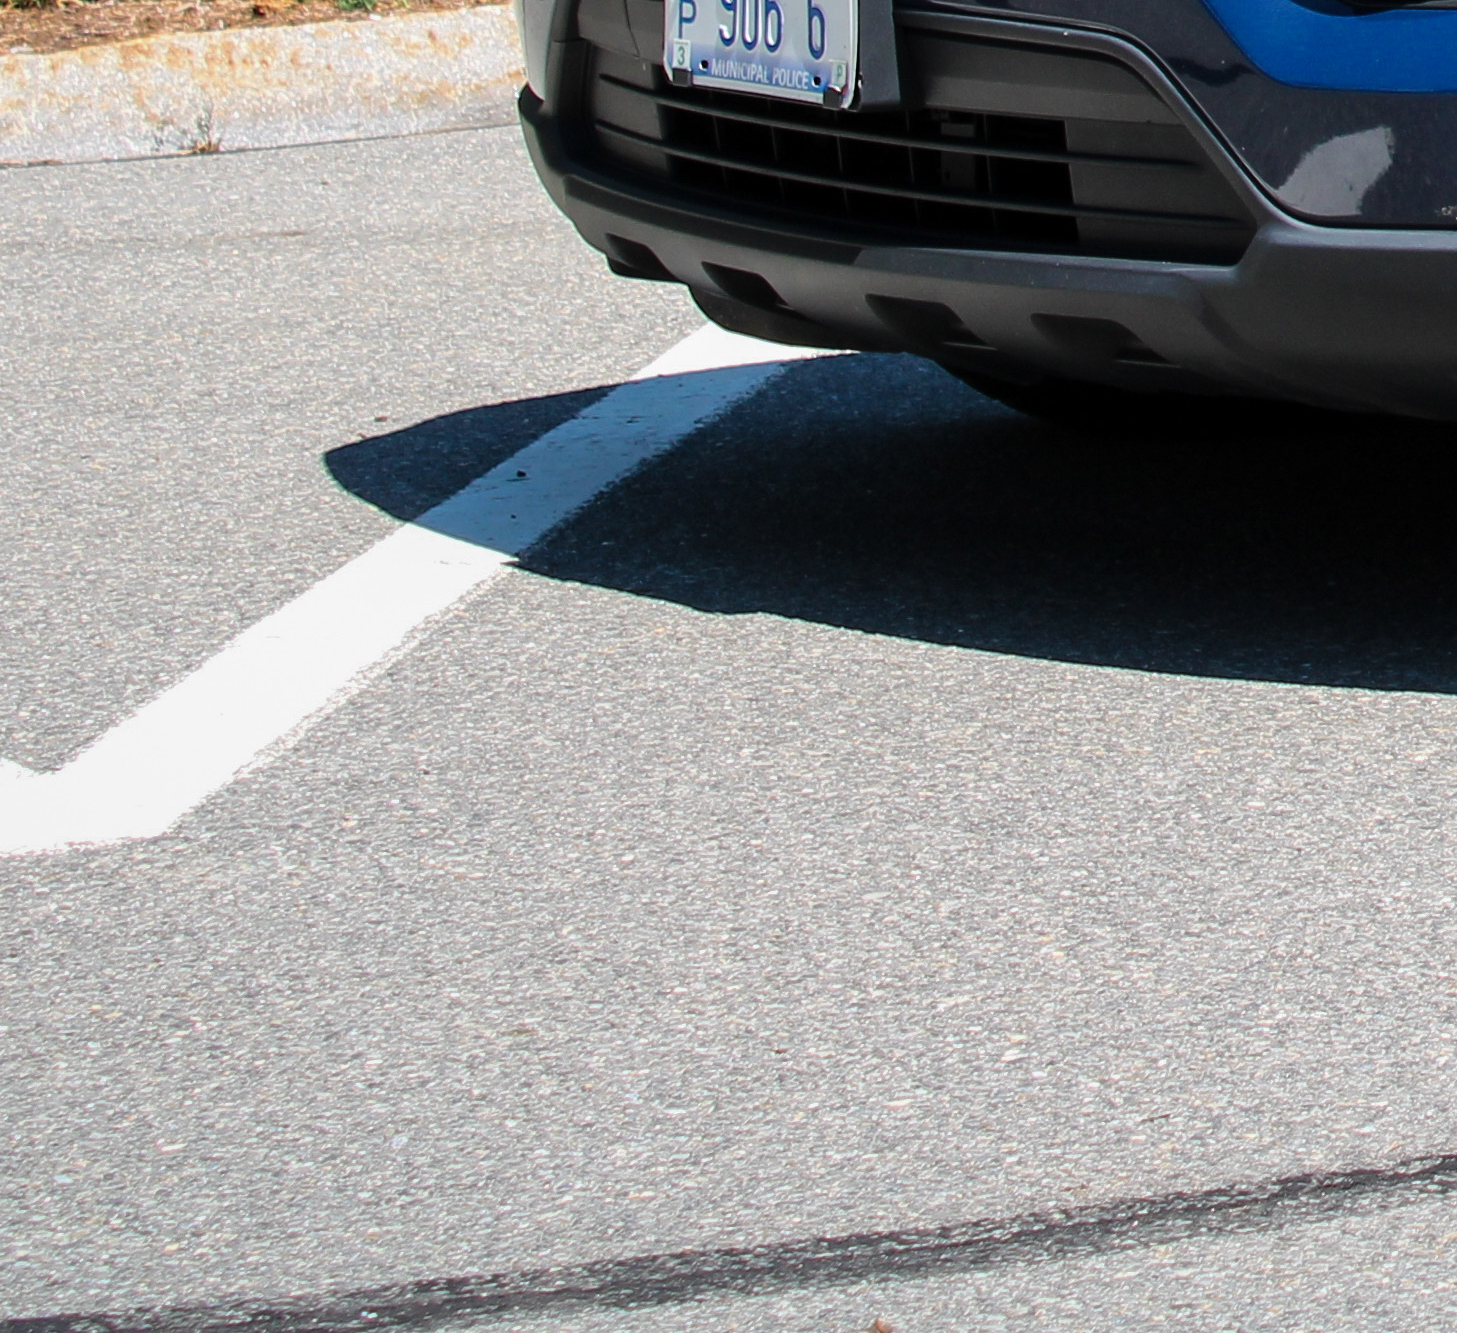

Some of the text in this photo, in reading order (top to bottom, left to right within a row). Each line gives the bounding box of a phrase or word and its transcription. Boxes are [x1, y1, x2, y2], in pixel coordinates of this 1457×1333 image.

[676, 45, 686, 66] 3
[711, 58, 809, 90] MUNICIPAL POLICE
